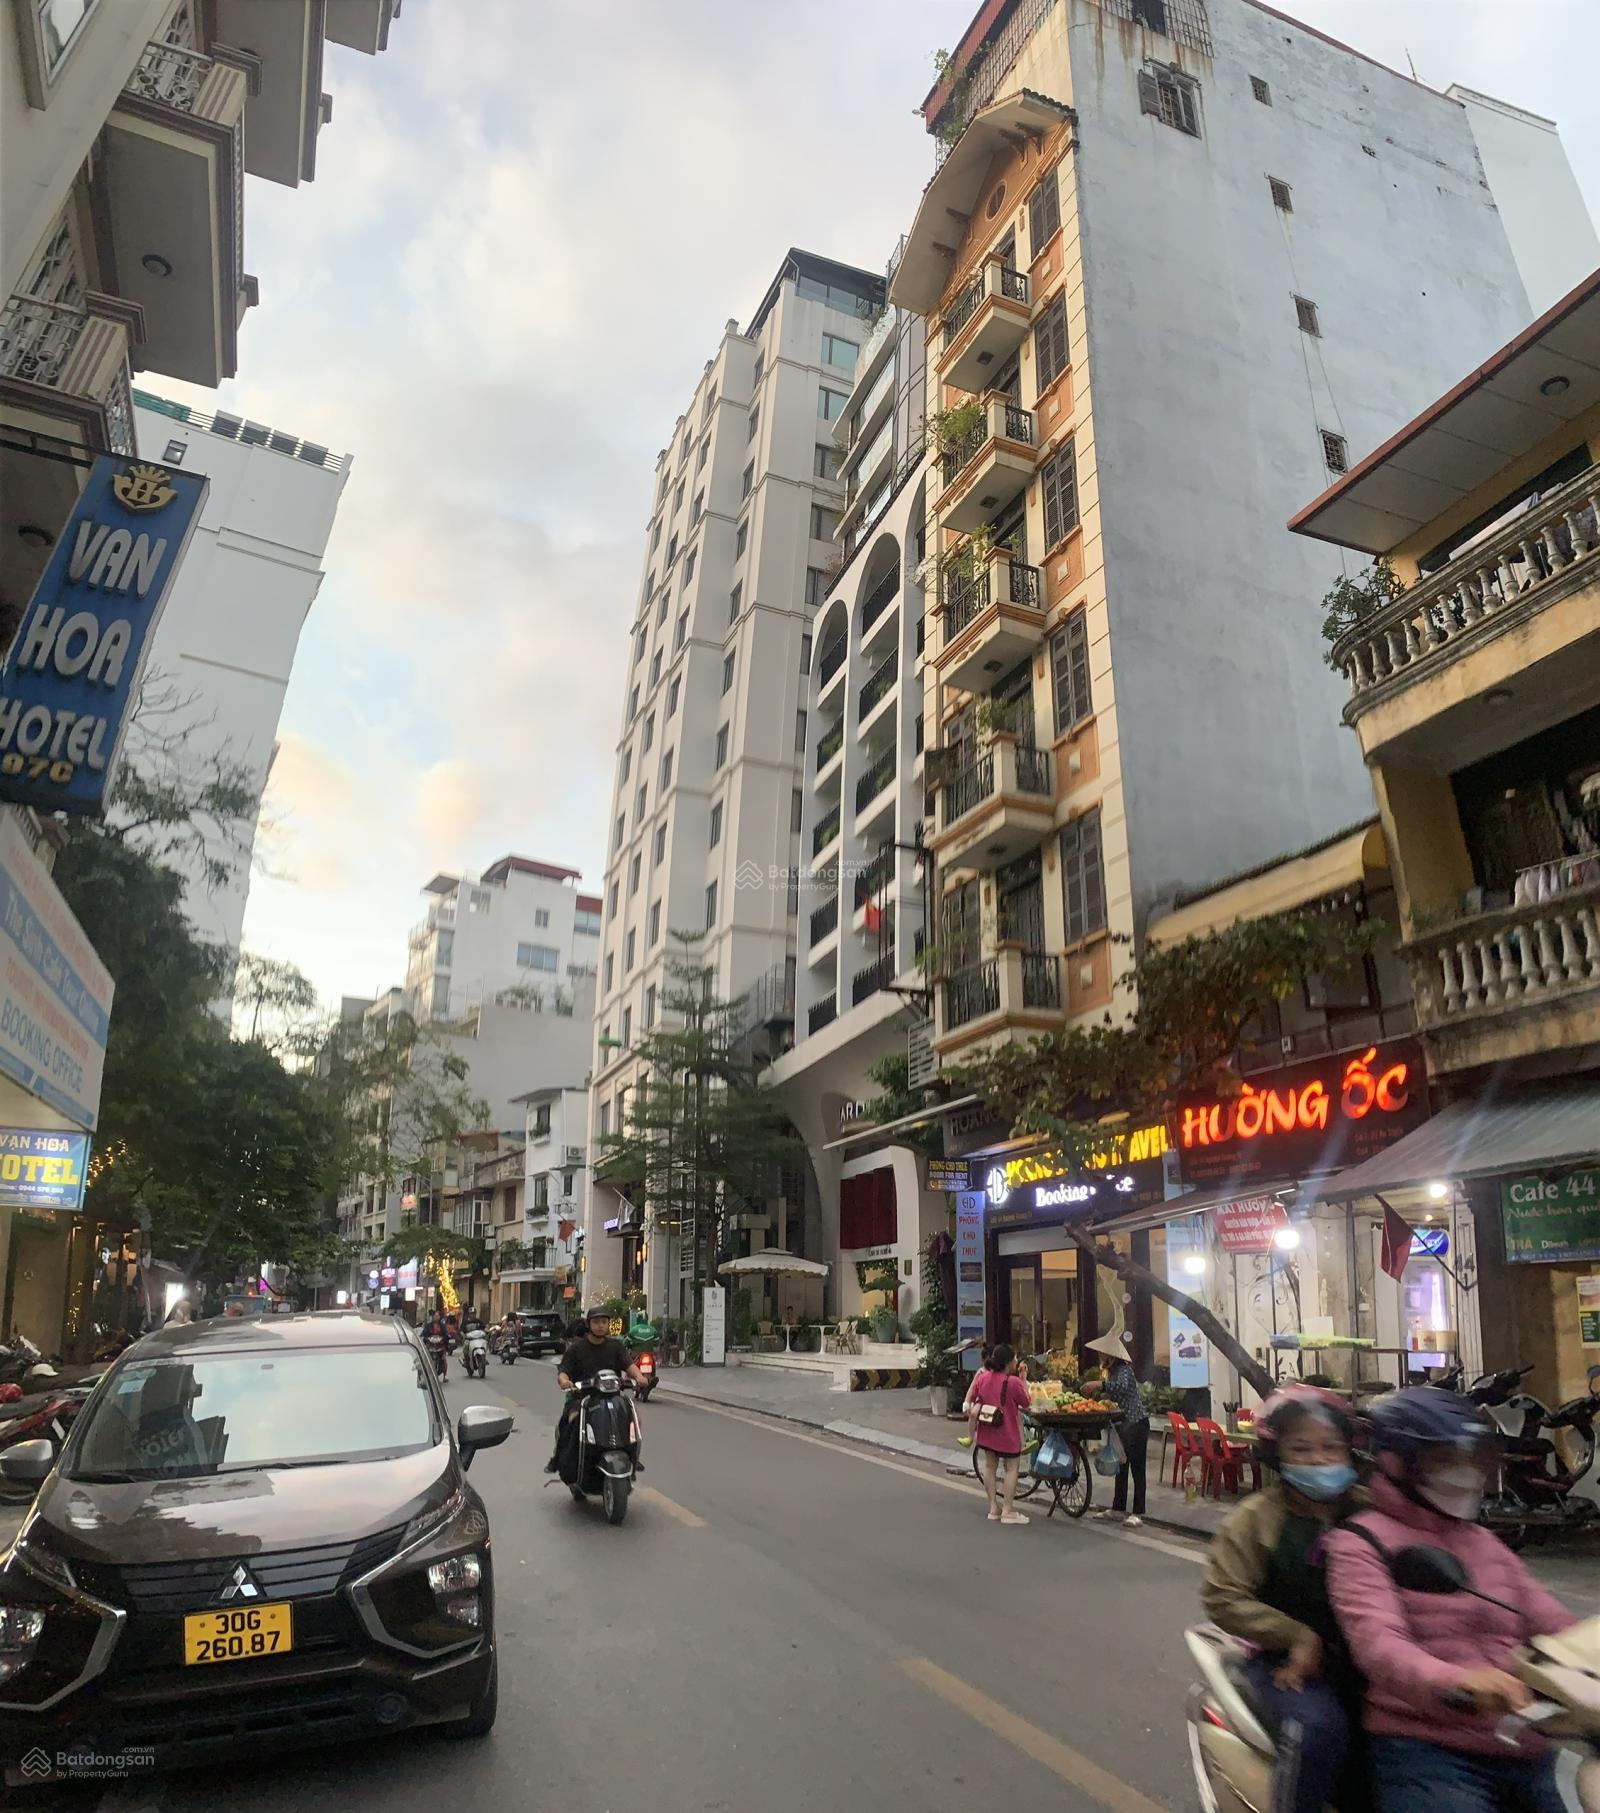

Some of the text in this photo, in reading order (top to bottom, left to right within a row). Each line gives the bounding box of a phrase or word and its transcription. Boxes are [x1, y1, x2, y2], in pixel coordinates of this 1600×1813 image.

[69, 519, 167, 596] VAN
[17, 603, 132, 687] HOA
[0, 697, 107, 769] HOTEL
[1, 997, 51, 1068] BOOKING
[52, 1045, 84, 1093] OFFICE
[1341, 1047, 1408, 1119] ỐC
[0, 1153, 79, 1185] OTEL
[1036, 1183, 1090, 1207] Booking
[1566, 1174, 1596, 1197] 44
[196, 1630, 281, 1661] 260.87
[215, 1610, 261, 1635] 30G
